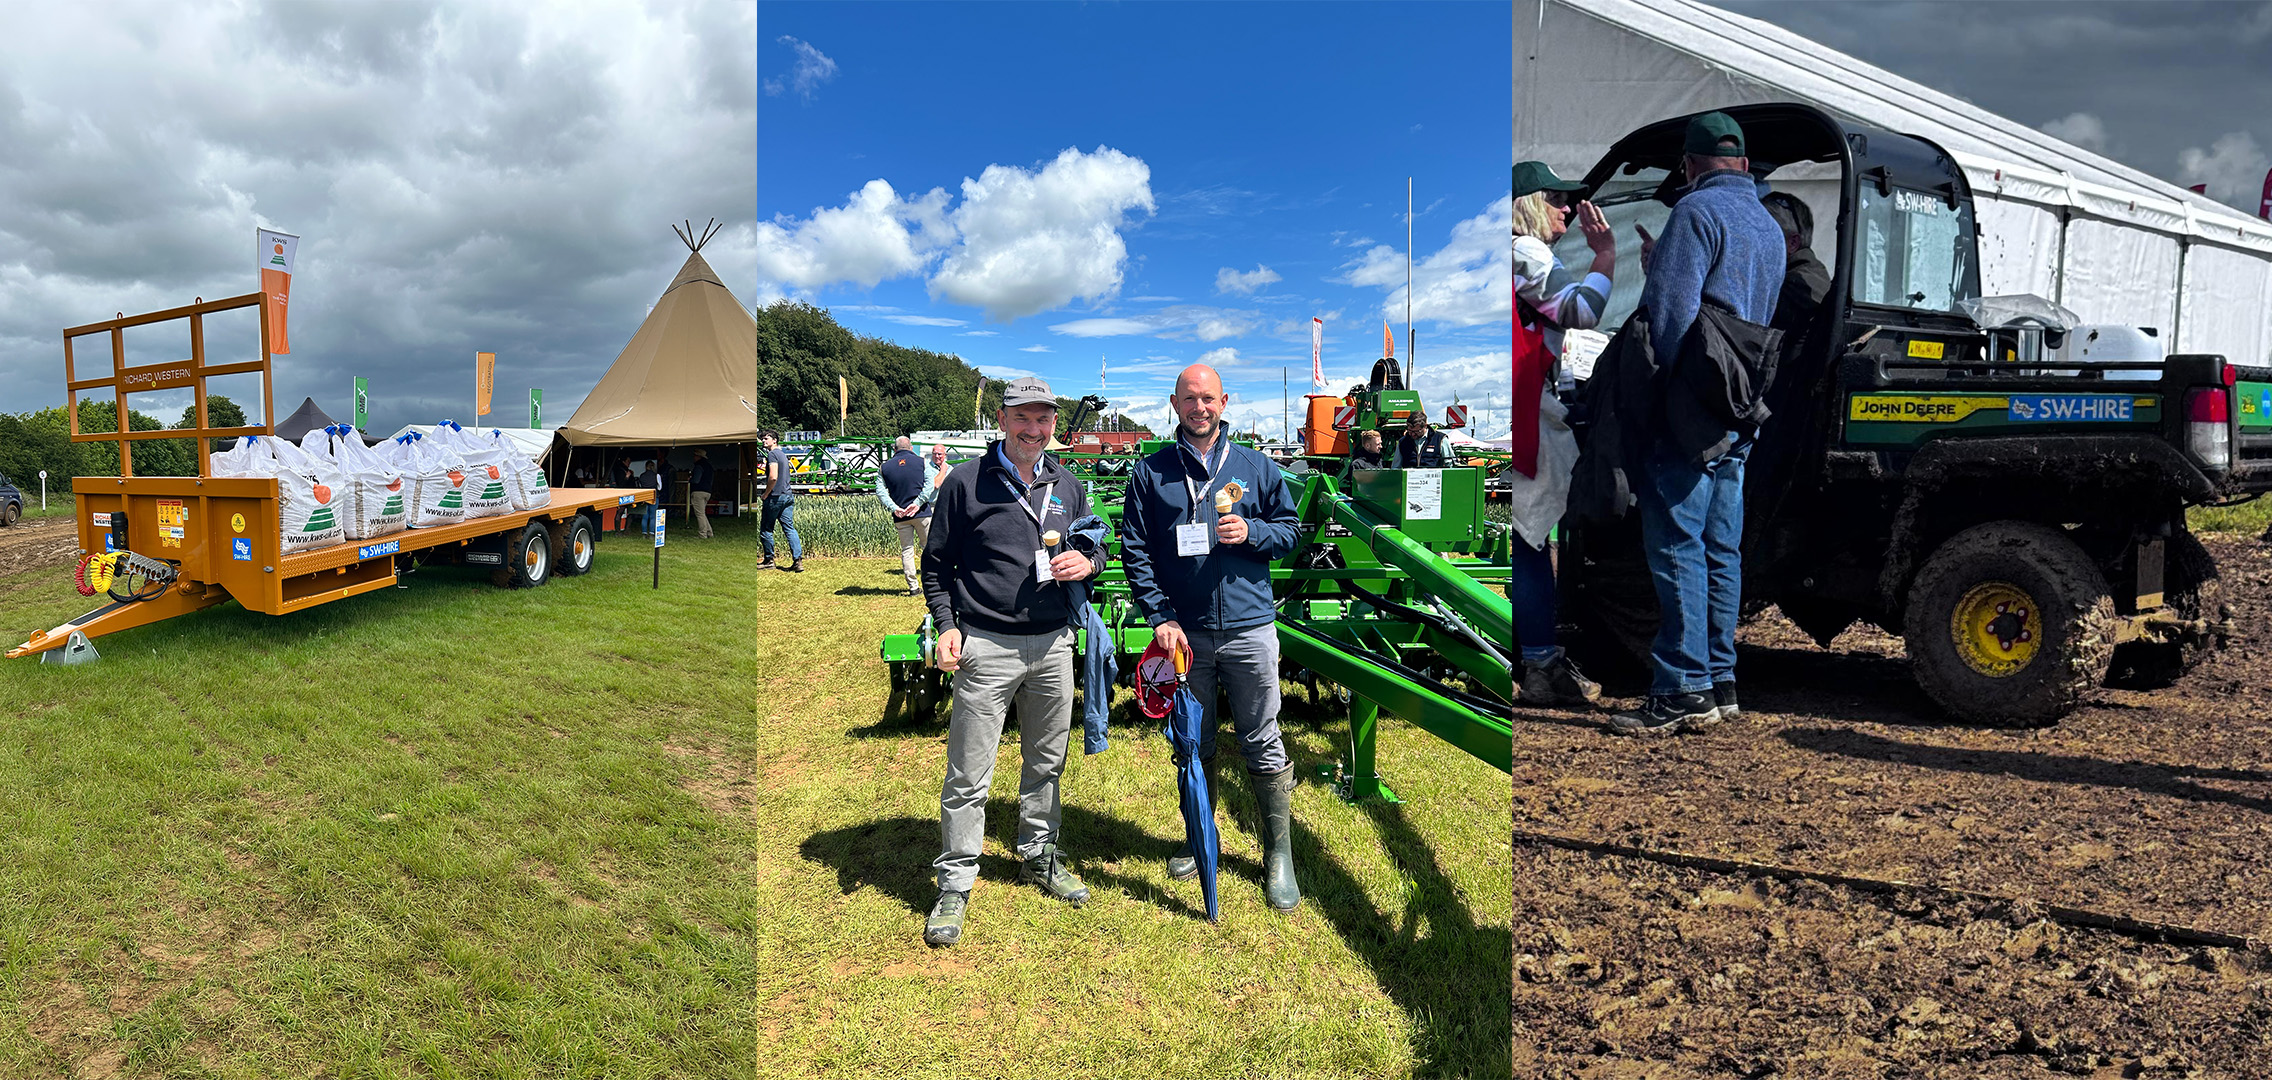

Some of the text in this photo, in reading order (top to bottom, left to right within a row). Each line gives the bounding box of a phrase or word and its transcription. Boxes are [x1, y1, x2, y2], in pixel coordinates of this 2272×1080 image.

[1906, 192, 1938, 216] SW-HIRE
[123, 368, 191, 385] RICHARD WESTERN
[1860, 401, 1956, 415] JOHN DEERE
[2039, 399, 2131, 420] SW-HIRE
[369, 542, 399, 557] SW-HIRE
